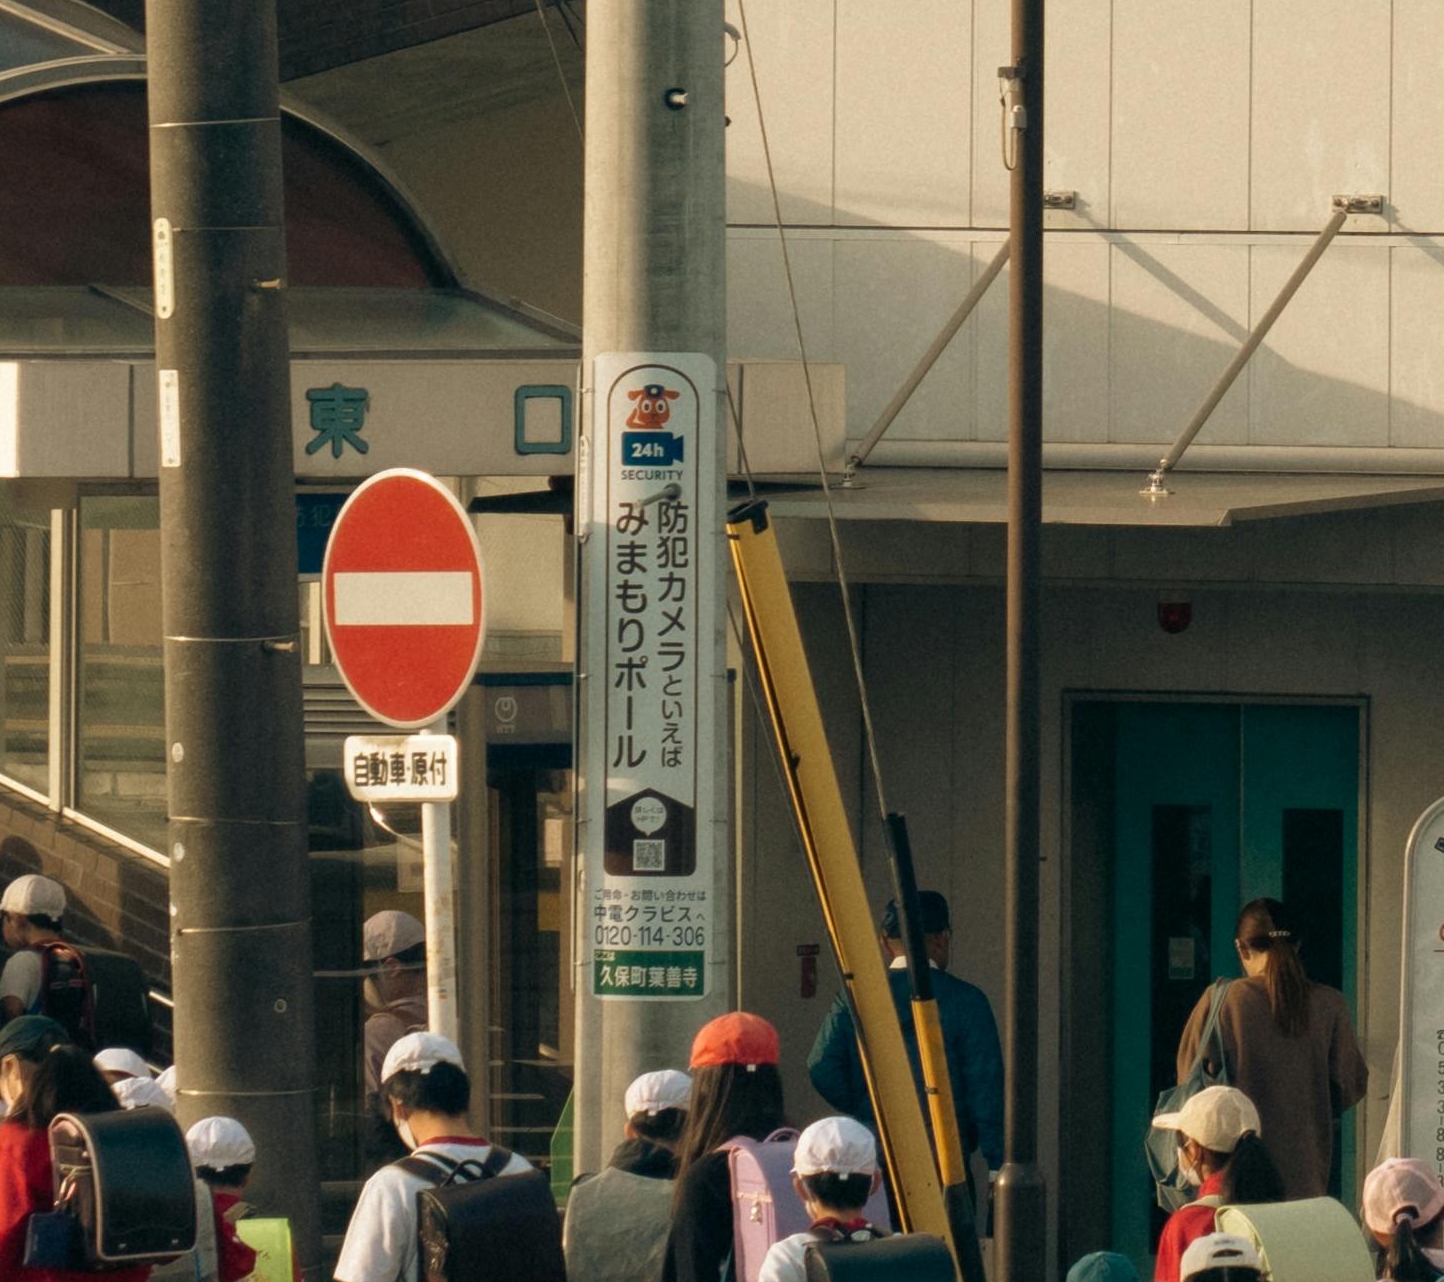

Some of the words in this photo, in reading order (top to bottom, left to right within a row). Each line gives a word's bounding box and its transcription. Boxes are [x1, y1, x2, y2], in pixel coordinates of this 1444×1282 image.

[631, 443, 665, 458] 24h
[621, 470, 684, 481] SECURITY
[613, 502, 648, 768] みまもりポール
[657, 501, 689, 768] 防犯カメラといえば
[354, 751, 447, 787] 自動車・原付
[595, 925, 705, 947] 0120-114-306
